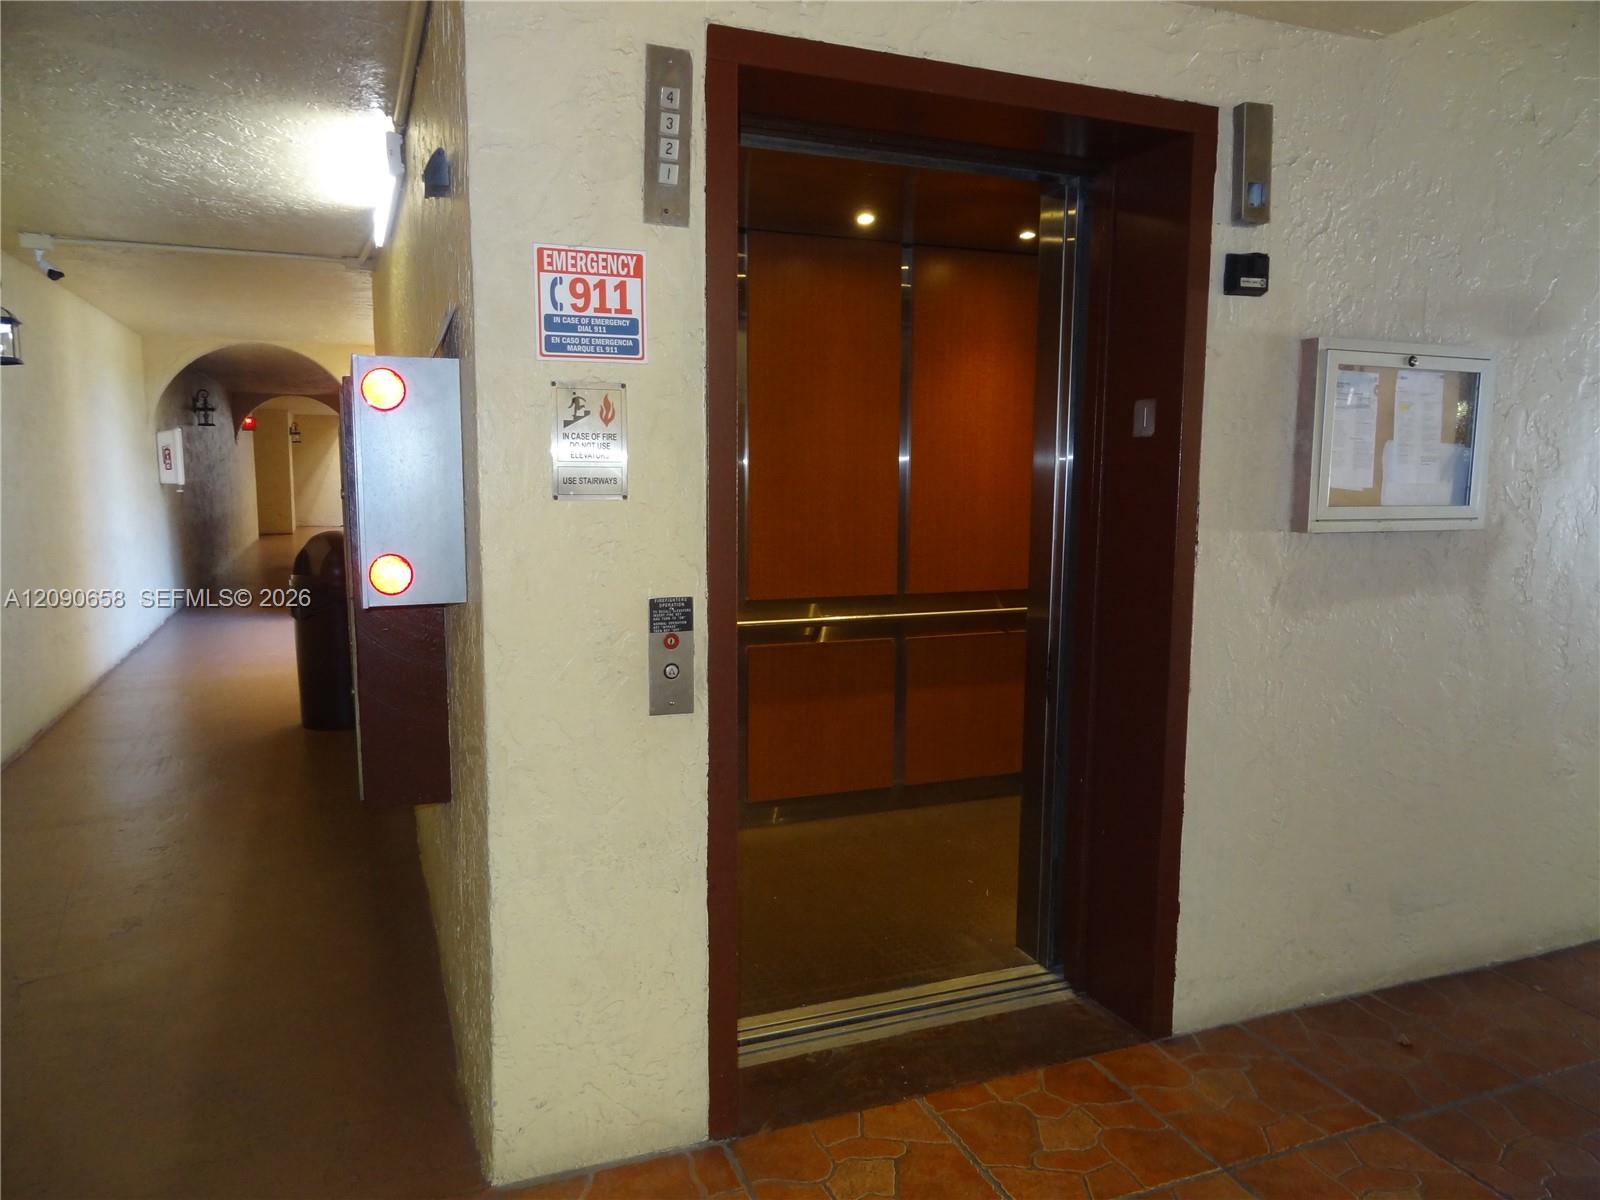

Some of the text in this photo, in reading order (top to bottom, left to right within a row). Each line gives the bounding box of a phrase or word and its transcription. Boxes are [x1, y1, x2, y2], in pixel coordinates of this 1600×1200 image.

[666, 91, 674, 104] 4
[666, 117, 674, 130] 3
[665, 142, 673, 155] 2
[544, 250, 637, 276] EMERGENCY
[569, 277, 632, 315] 911
[591, 318, 630, 326] EMERGENCY
